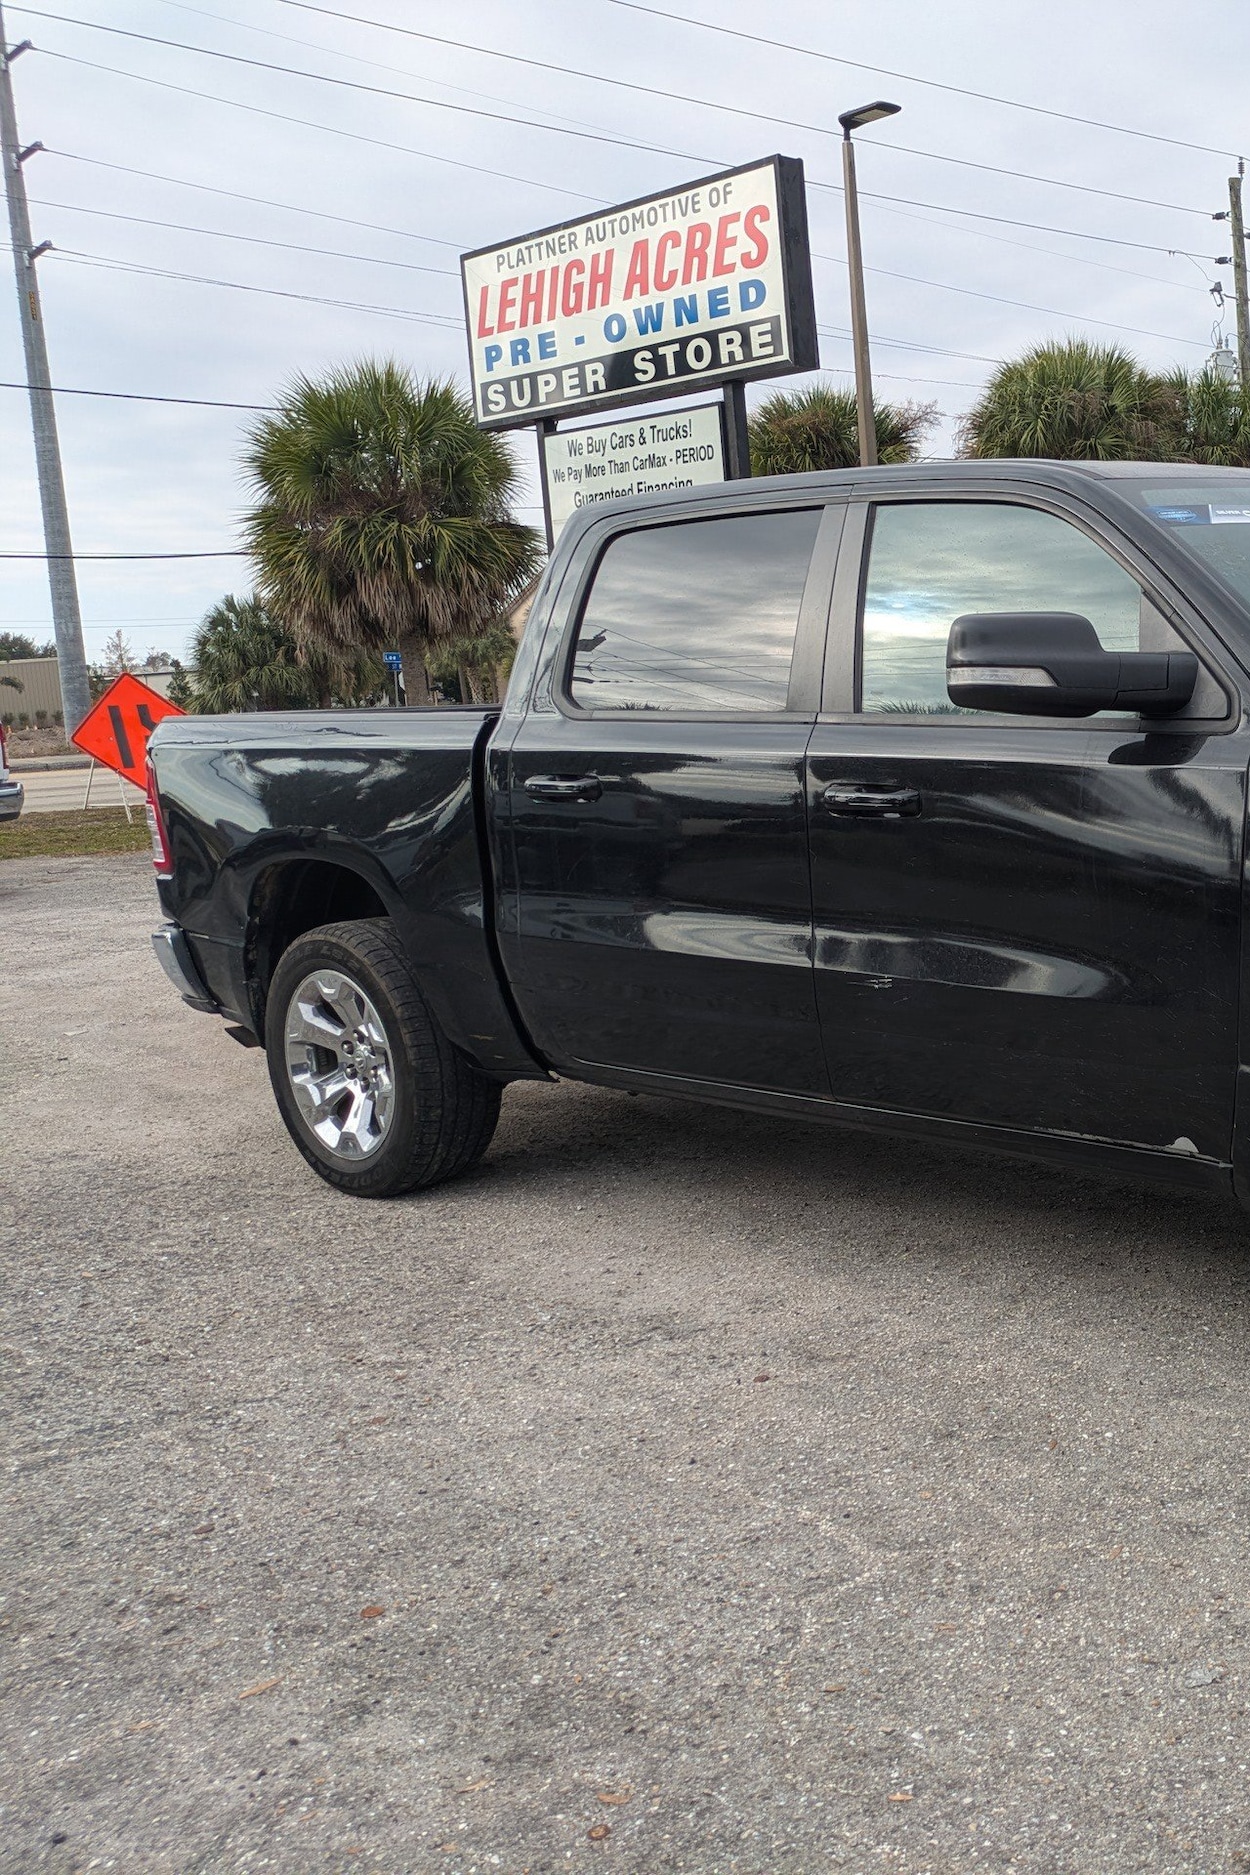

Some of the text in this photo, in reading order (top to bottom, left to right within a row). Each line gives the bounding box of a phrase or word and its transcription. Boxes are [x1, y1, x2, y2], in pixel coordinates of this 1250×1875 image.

[477, 204, 771, 339] LEHIGH ACRES
[496, 182, 733, 273] PLATTNER AUTOMOTIVE OF
[485, 330, 558, 372] PRE
[604, 279, 767, 344] OWNED
[487, 322, 775, 413] SUPER STORE
[553, 468, 566, 484] We
[567, 466, 582, 484] Pay
[584, 463, 606, 480] More
[608, 458, 630, 475] Than
[632, 453, 667, 471] CarMax
[675, 444, 714, 466] PERIOD
[567, 418, 692, 457] We Buy Cars & Trucks!
